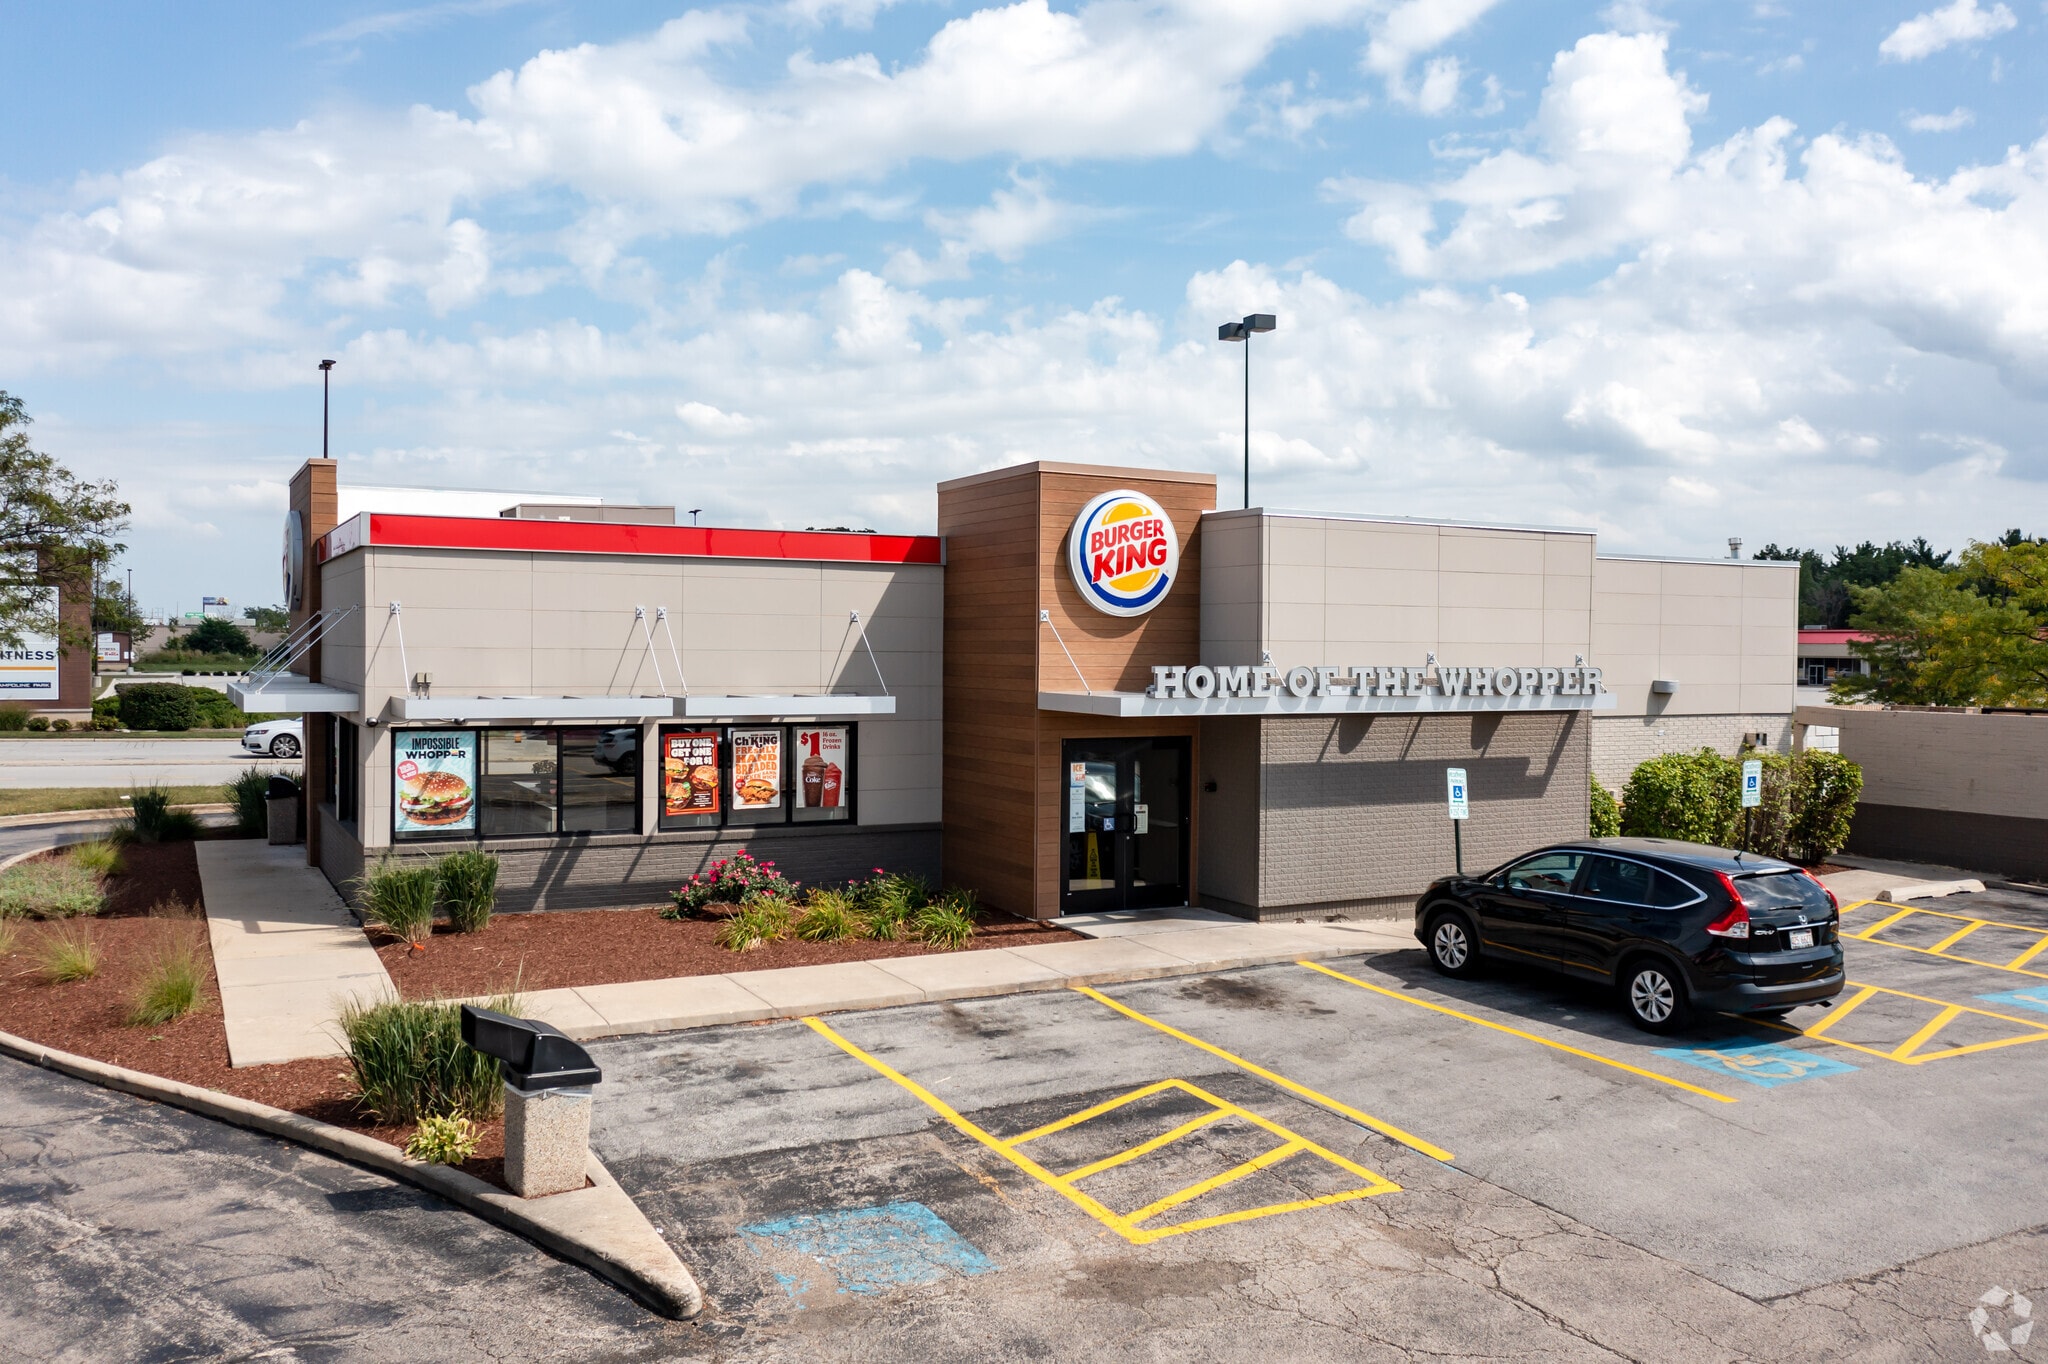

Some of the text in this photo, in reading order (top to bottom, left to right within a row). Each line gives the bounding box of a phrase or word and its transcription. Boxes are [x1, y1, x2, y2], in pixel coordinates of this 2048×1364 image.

[1091, 519, 1164, 553] BURGER
[1092, 538, 1167, 583] KING
[1152, 665, 1603, 699] HOME OF THE WHOPPER
[412, 737, 460, 750] IMPOSSIBLE
[671, 738, 714, 748] BUY ONE,
[801, 731, 820, 757] $1
[671, 747, 712, 757] GET ONE
[736, 754, 777, 763] HAND
[684, 756, 712, 765] FOR $1
[736, 761, 777, 775] BREADED
[805, 776, 821, 784] Coke
